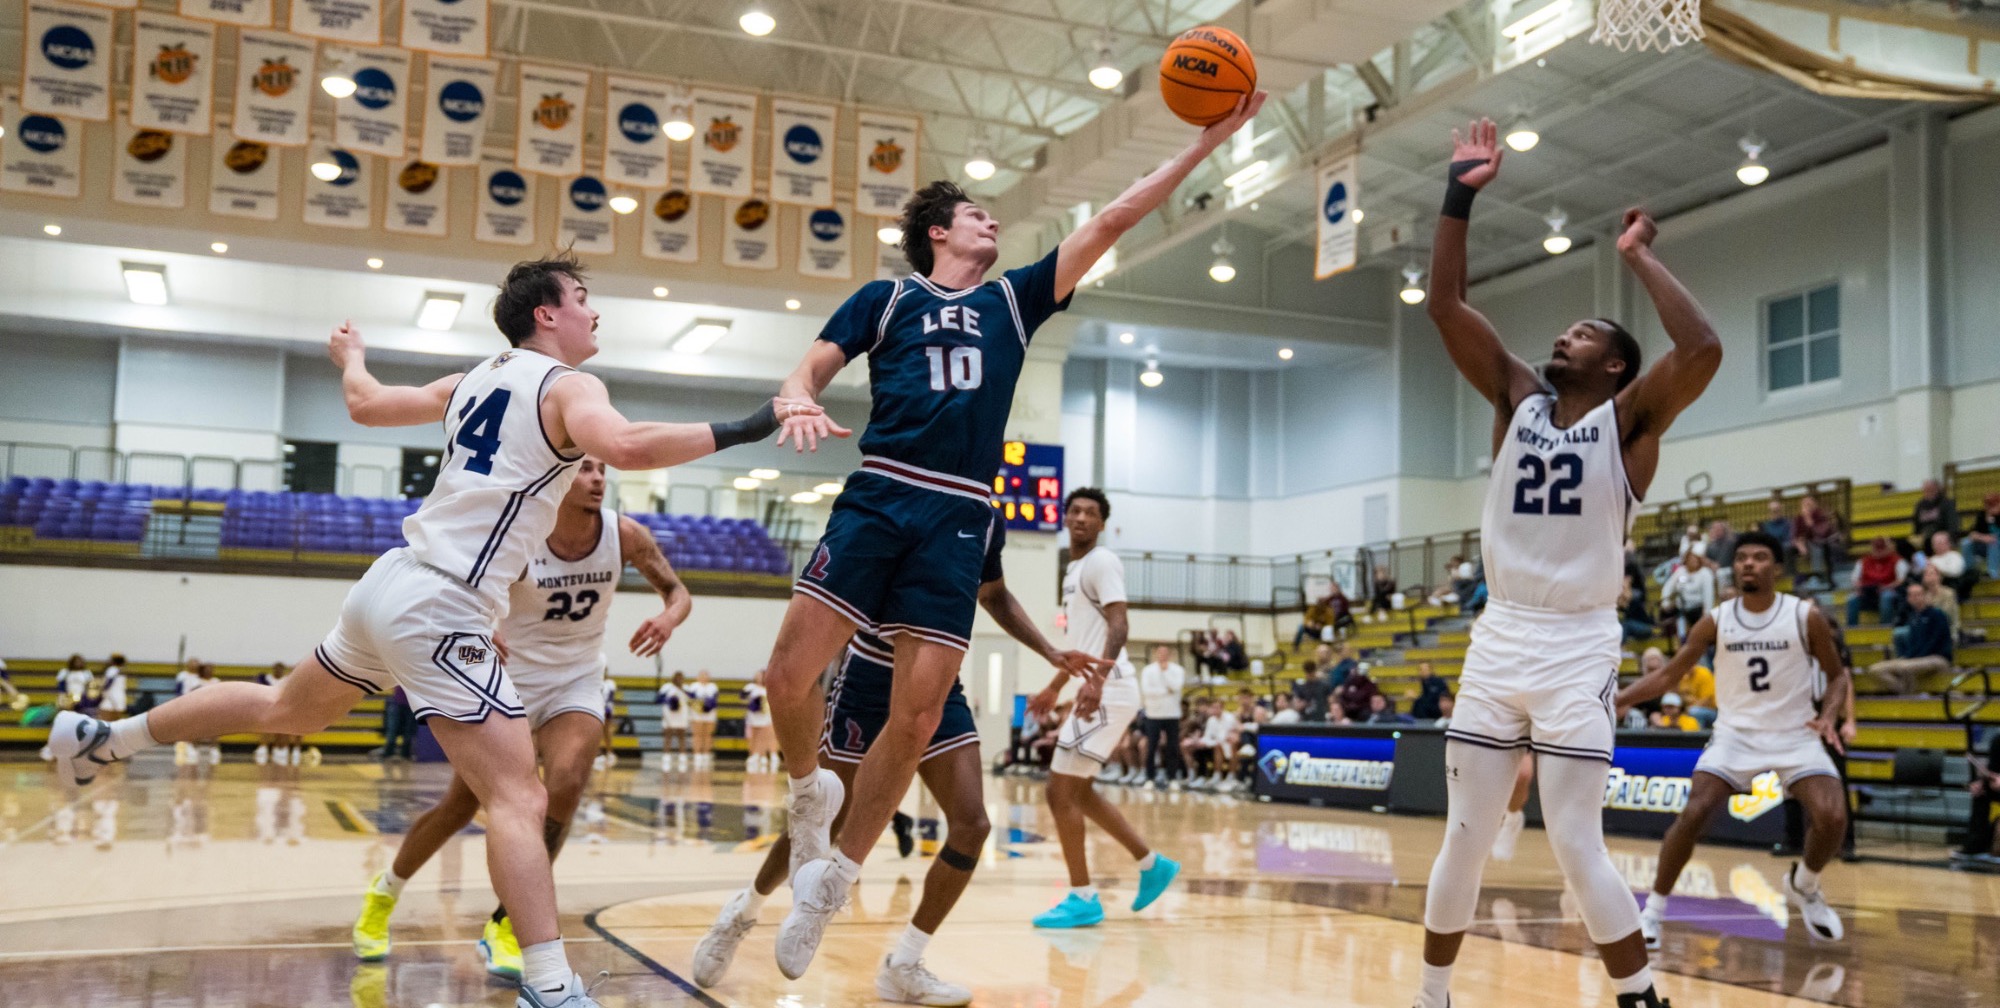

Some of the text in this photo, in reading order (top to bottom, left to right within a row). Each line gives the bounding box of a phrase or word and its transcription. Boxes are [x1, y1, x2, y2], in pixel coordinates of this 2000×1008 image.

[46, 42, 96, 62] NCAA
[1173, 54, 1218, 77] NCAA
[921, 305, 982, 337] LEE
[925, 346, 982, 391] 10
[1513, 453, 1583, 515] 22
[537, 571, 613, 589] MONTEVALLO
[543, 590, 600, 622] 23
[458, 645, 487, 665] UM
[1725, 640, 1789, 652] MONTEVALLO
[1748, 658, 1770, 693] 2
